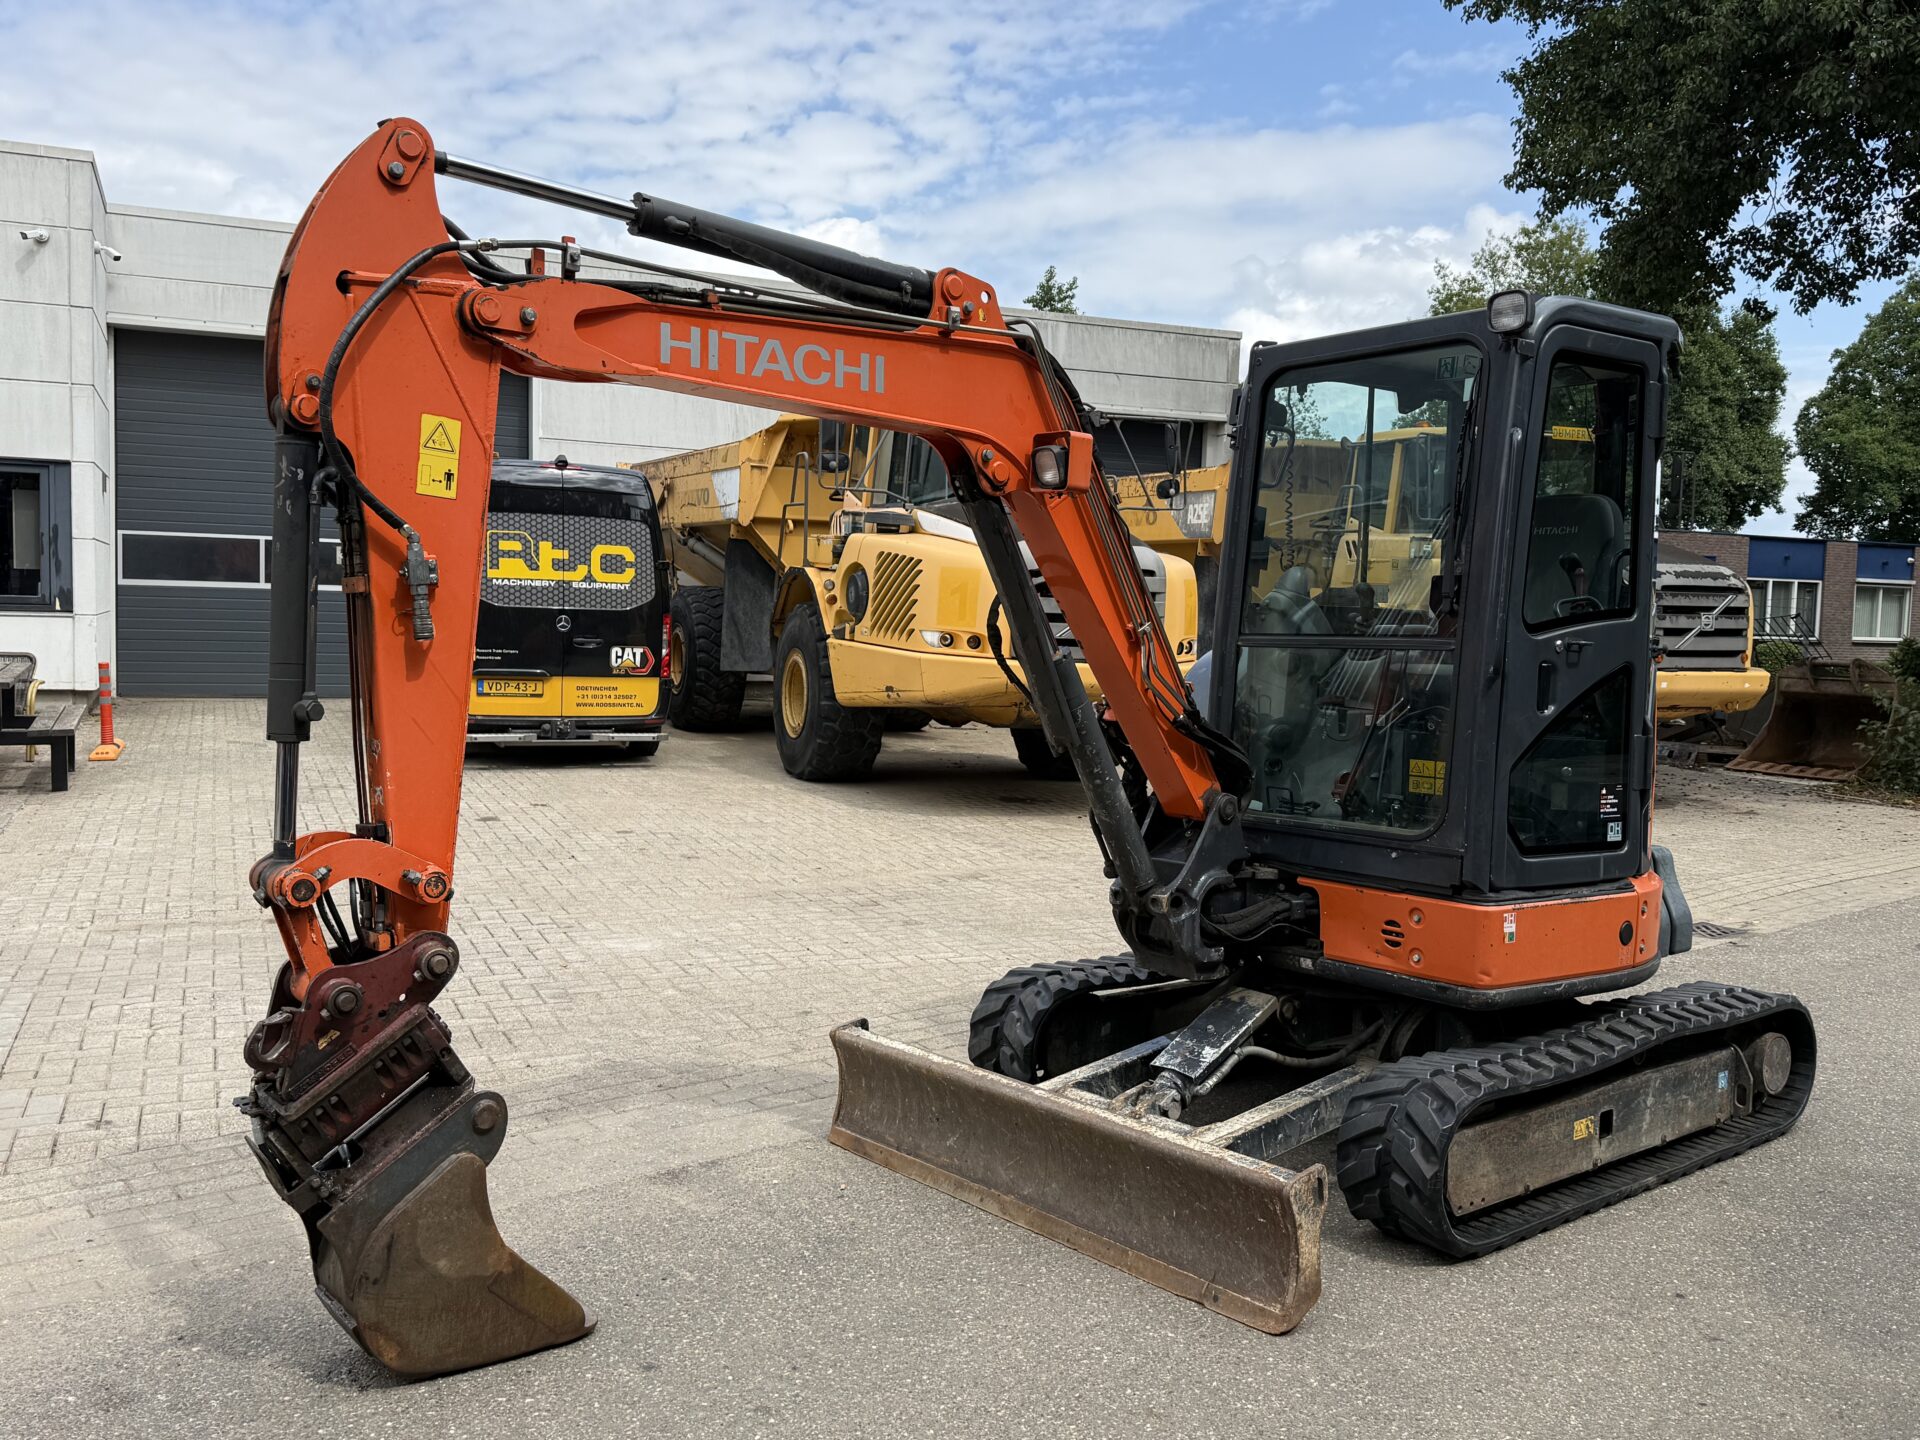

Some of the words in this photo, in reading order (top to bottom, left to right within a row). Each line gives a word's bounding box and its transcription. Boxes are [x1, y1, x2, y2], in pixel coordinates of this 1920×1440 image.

[660, 322, 885, 394] HITACHI
[1552, 427, 1586, 439] DUMPER
[1533, 525, 1579, 535] HITACHI
[492, 578, 556, 587] MACHINERY
[572, 581, 631, 590] EQUIPMENT
[611, 646, 644, 668] CAT
[487, 681, 538, 692] VDP-43-J
